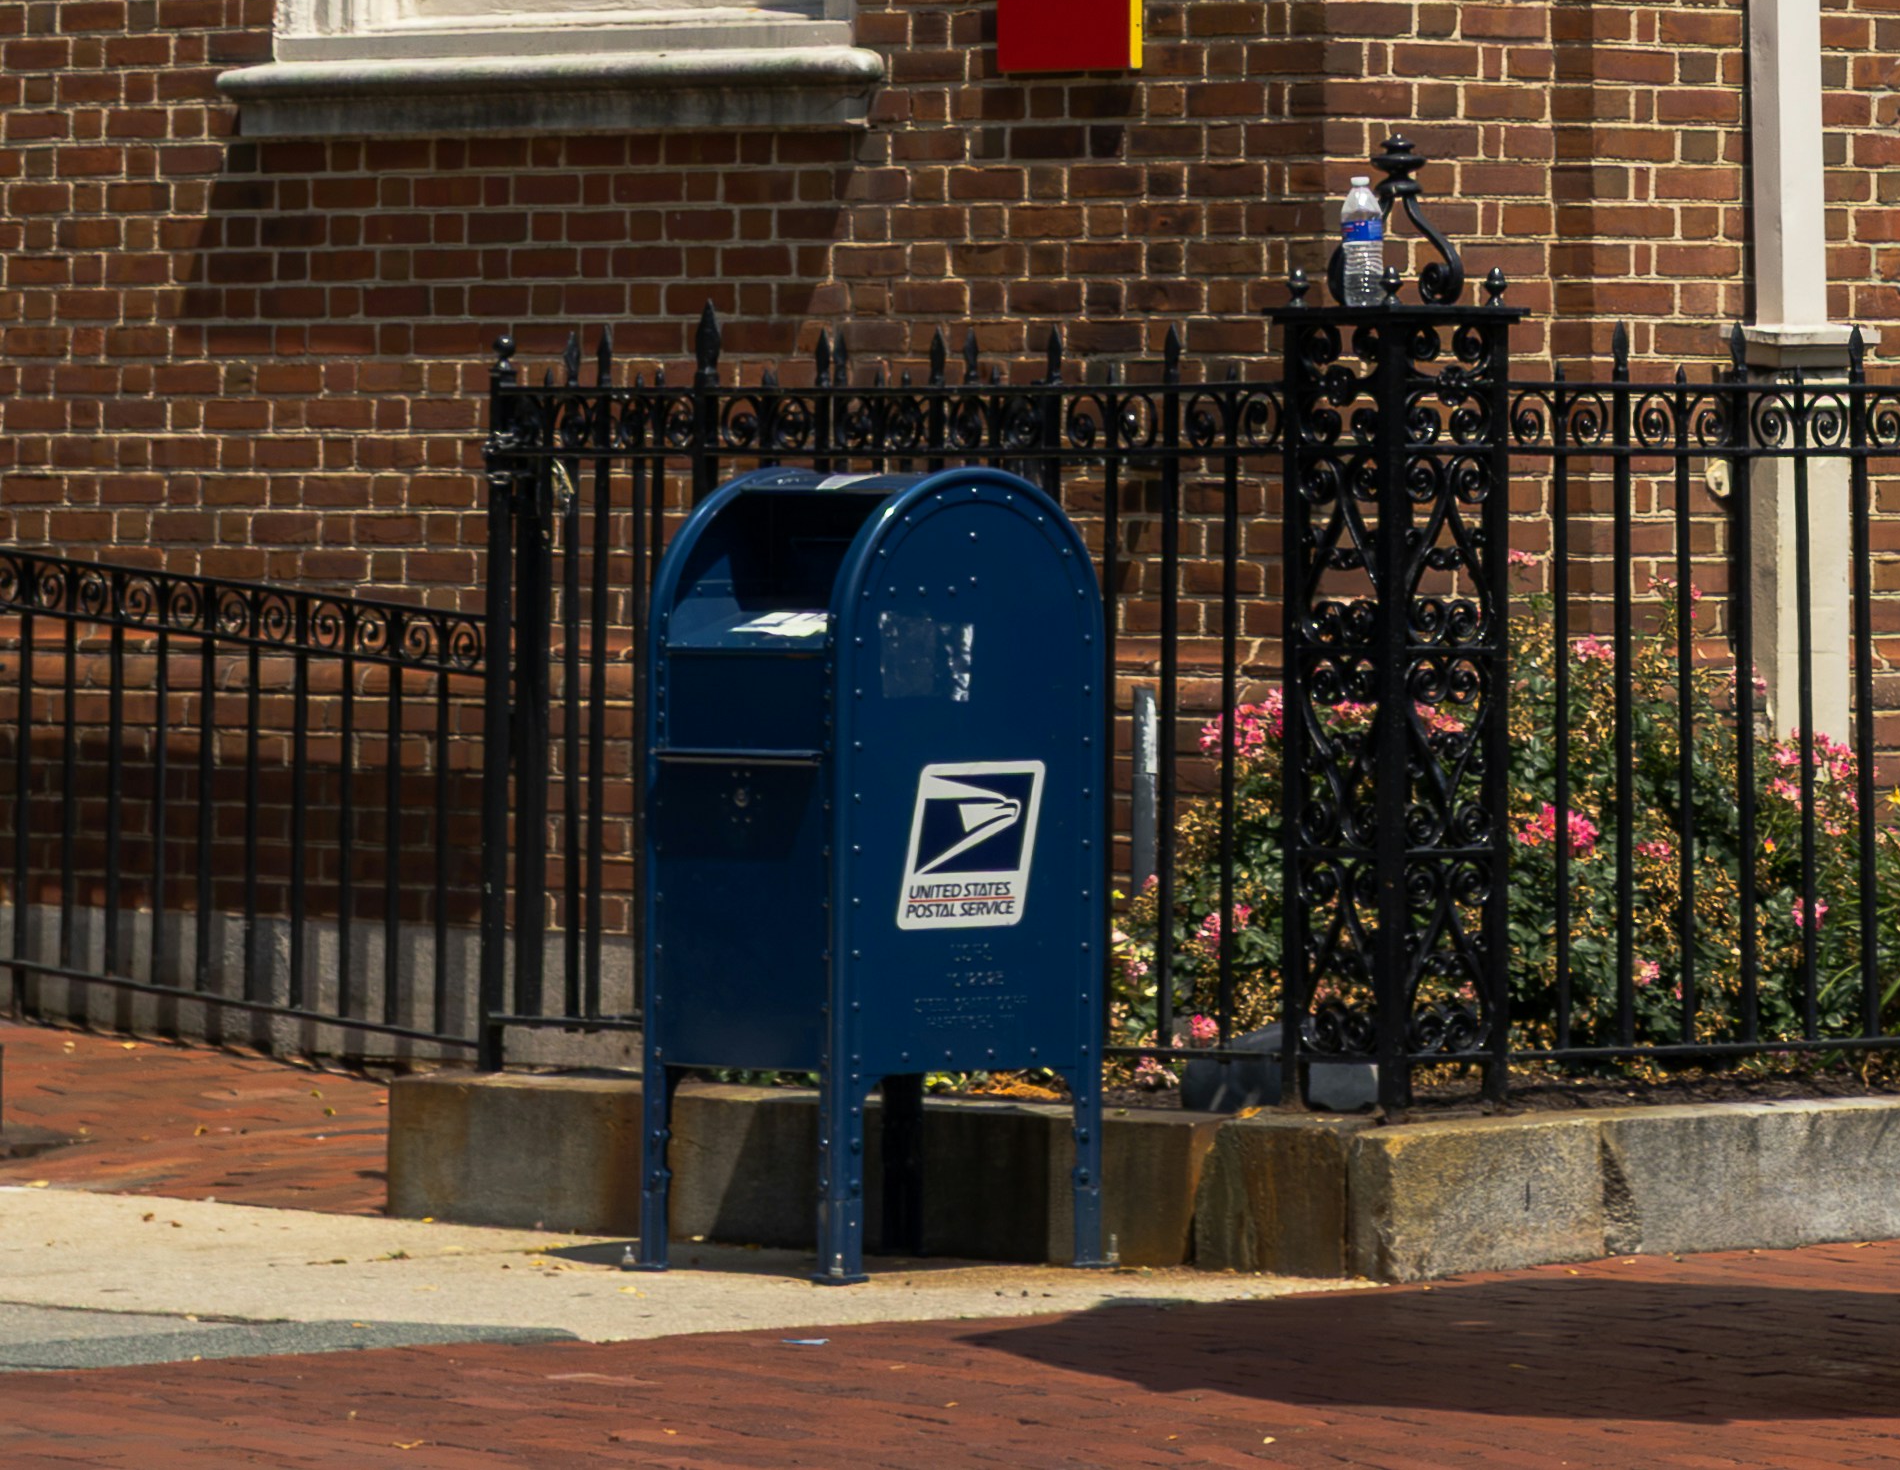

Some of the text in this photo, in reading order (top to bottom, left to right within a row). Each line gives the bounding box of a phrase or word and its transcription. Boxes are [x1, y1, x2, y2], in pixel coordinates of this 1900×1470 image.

[908, 881, 1012, 899] UNITED STATES
[905, 900, 1016, 919] POSTAL SERVICE
